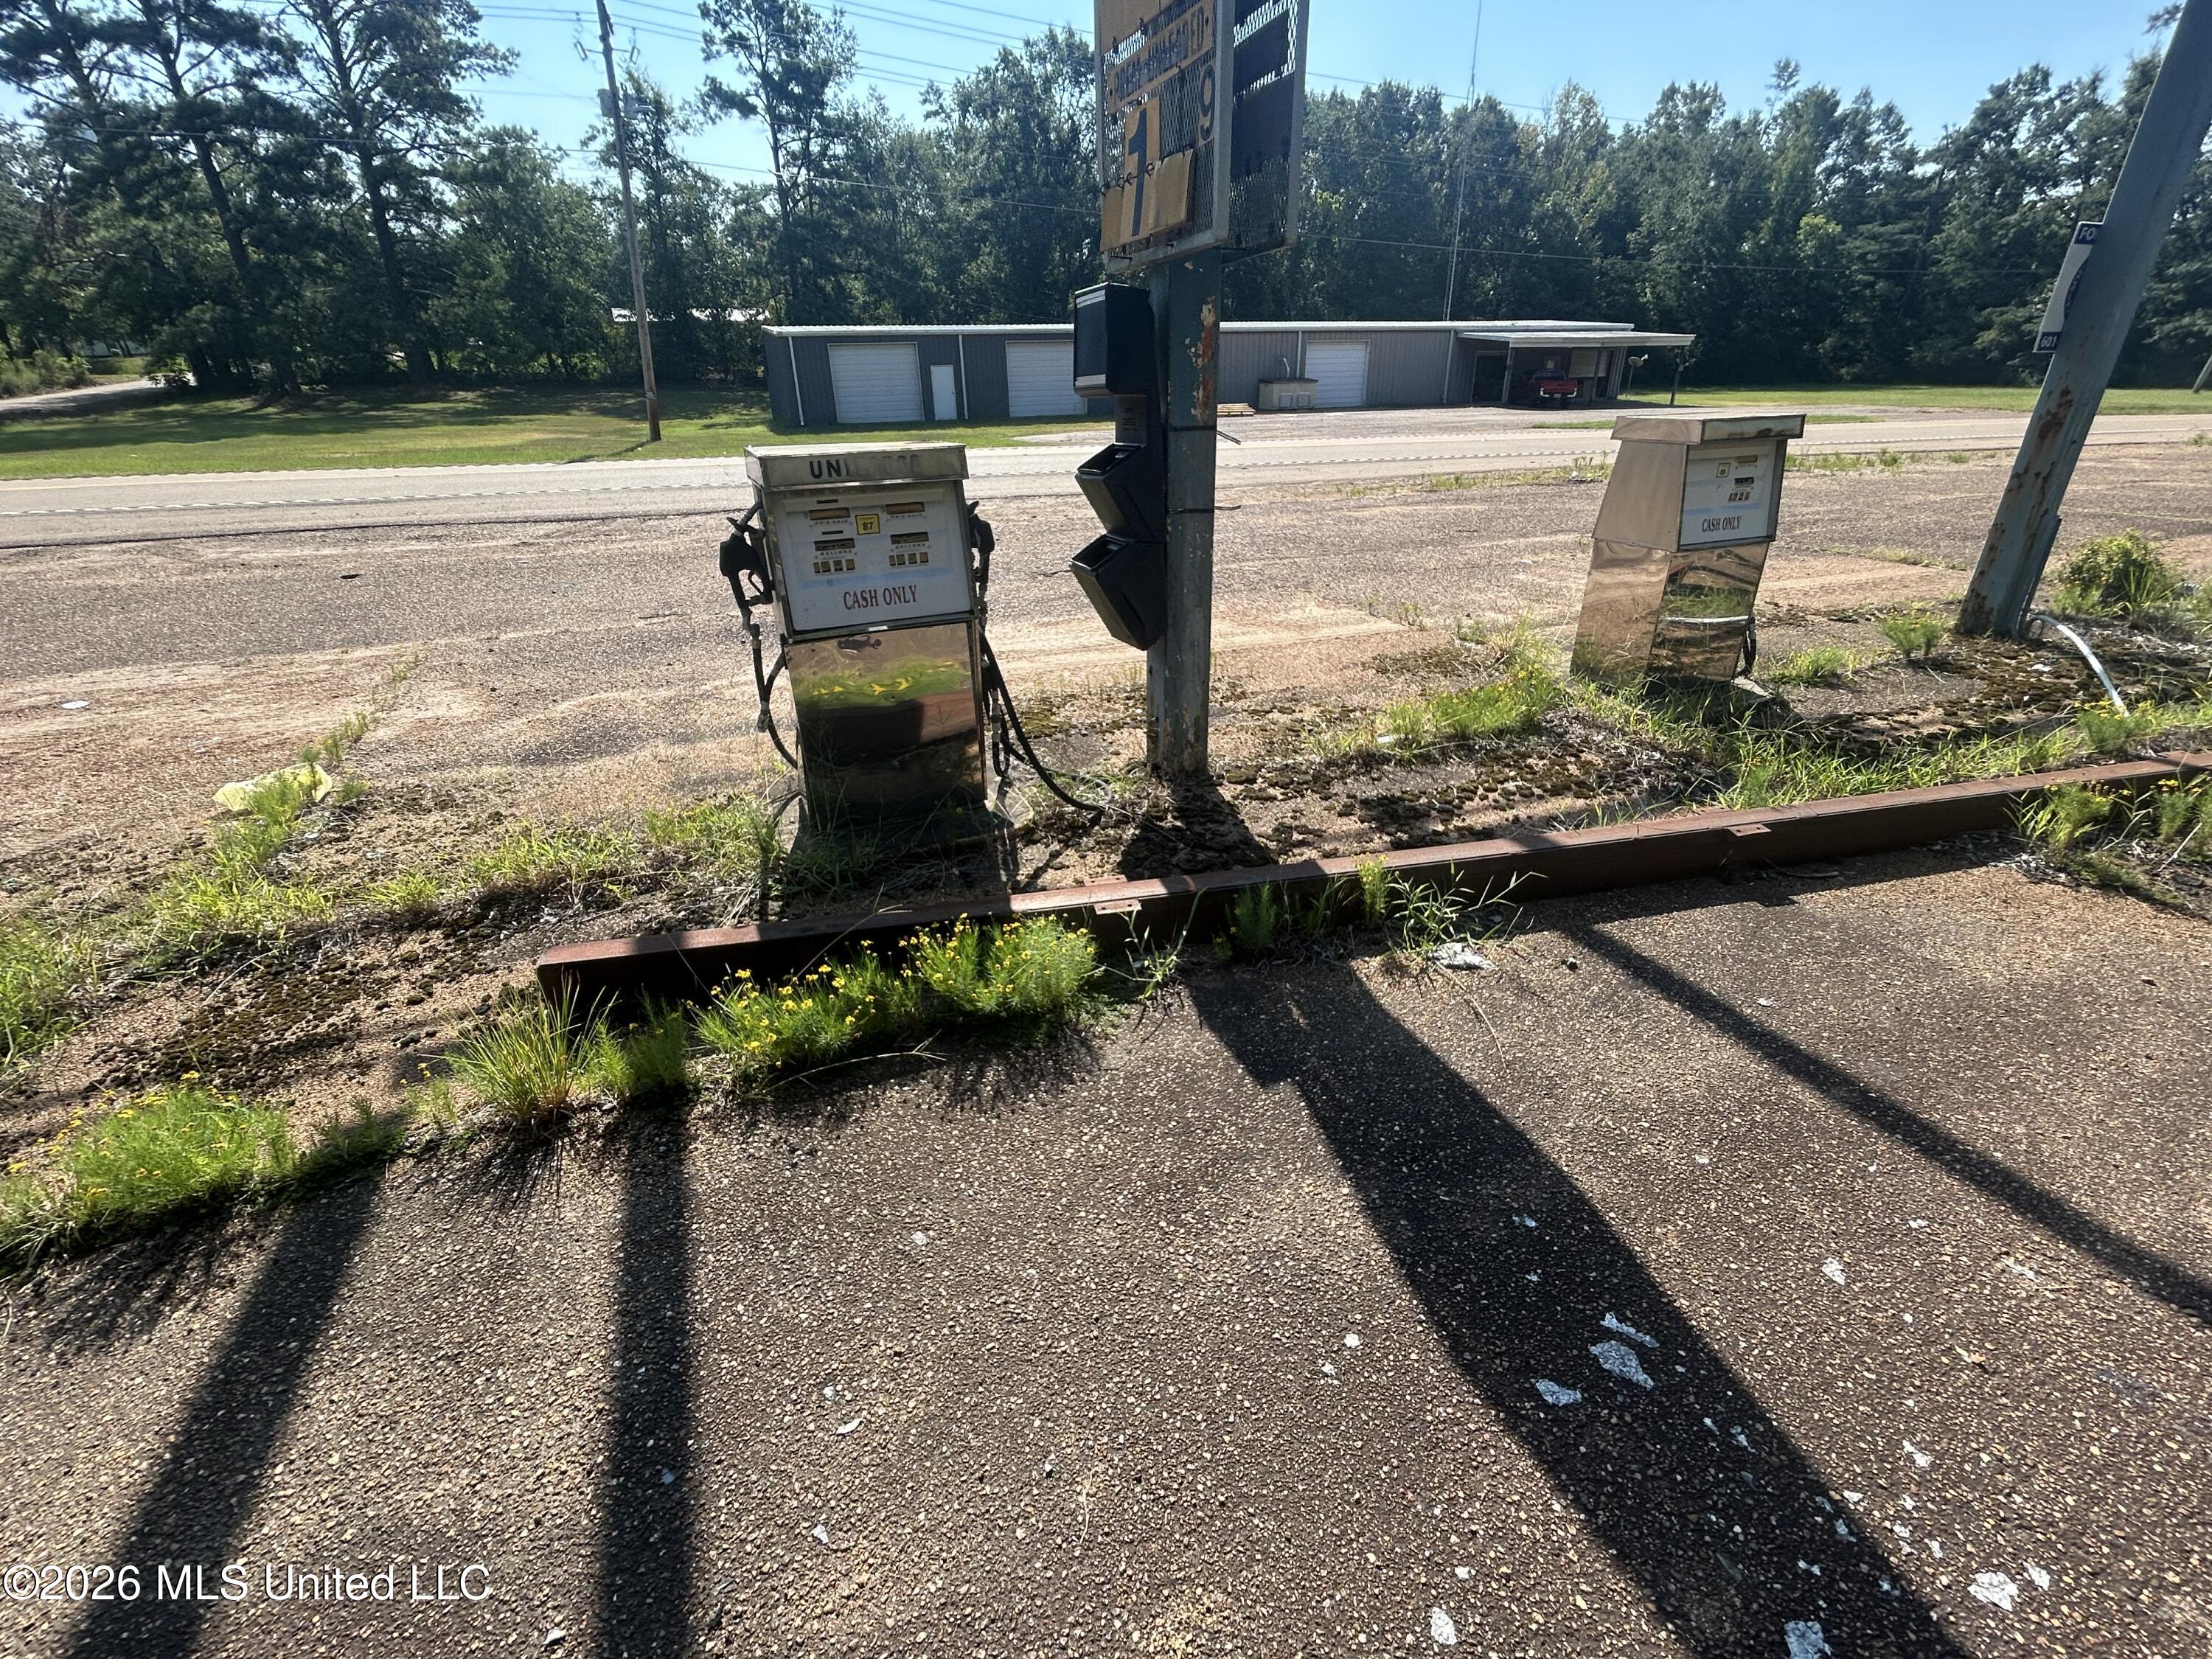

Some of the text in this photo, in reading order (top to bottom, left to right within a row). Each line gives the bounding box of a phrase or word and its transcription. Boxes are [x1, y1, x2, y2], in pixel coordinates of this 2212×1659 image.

[1127, 107, 1147, 237] 1
[1199, 64, 1215, 142] 9
[2040, 335, 2057, 347] 601
[862, 521, 874, 531] 87
[1702, 515, 1742, 532] CASH ONLY
[843, 585, 917, 611] CASH ONLY
